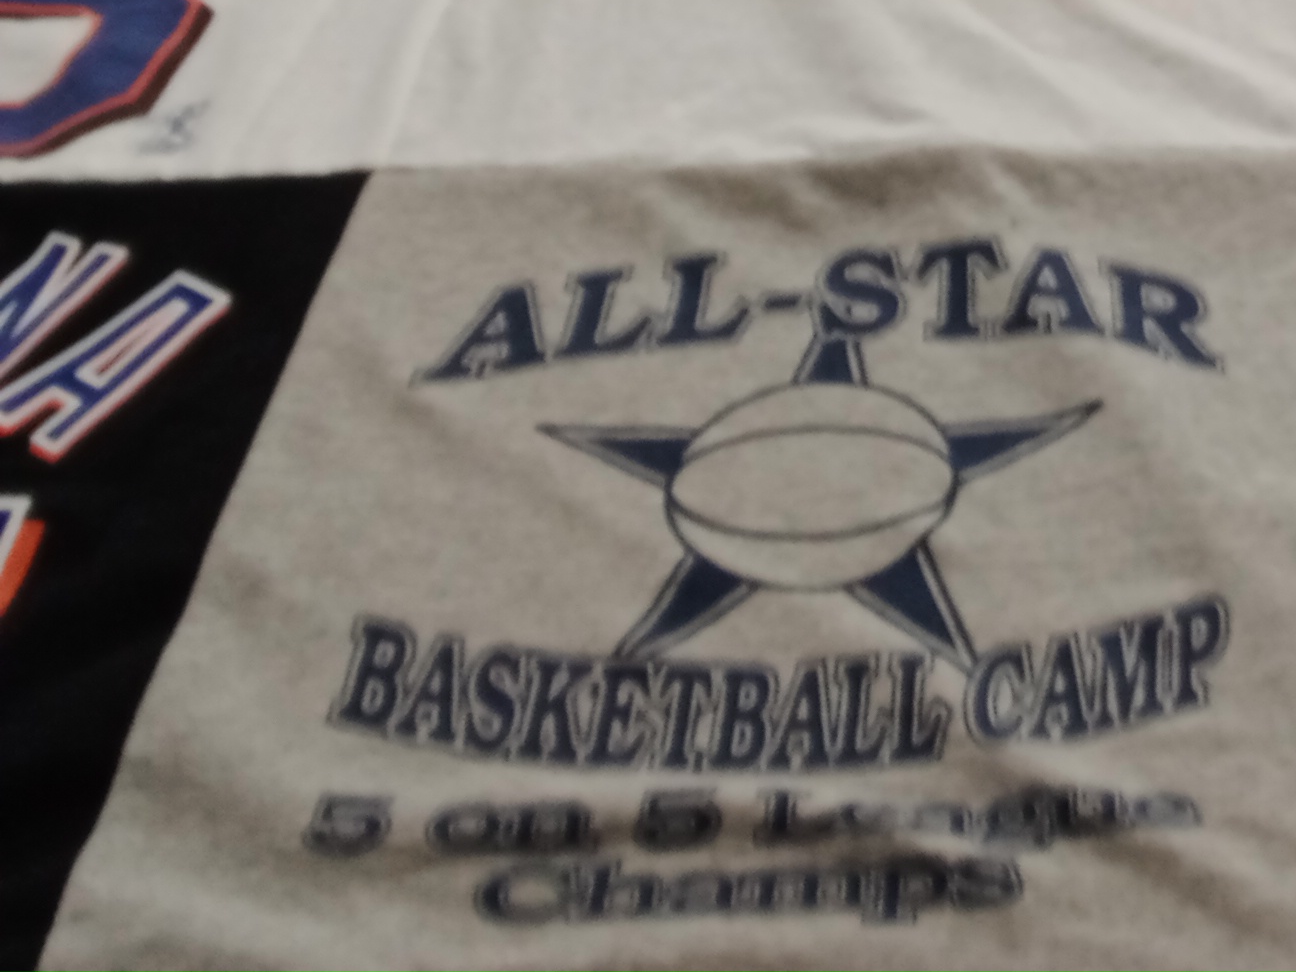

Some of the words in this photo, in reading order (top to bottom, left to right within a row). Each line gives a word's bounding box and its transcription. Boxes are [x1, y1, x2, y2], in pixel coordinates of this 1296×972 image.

[407, 236, 1225, 388] ALL-STAR
[328, 613, 954, 773] BASKETBALL
[964, 592, 1233, 748] CAMP
[302, 790, 393, 858] 5
[424, 800, 597, 856] on
[630, 788, 722, 853] 5
[751, 784, 1202, 854] League
[472, 853, 1026, 929] Champs
